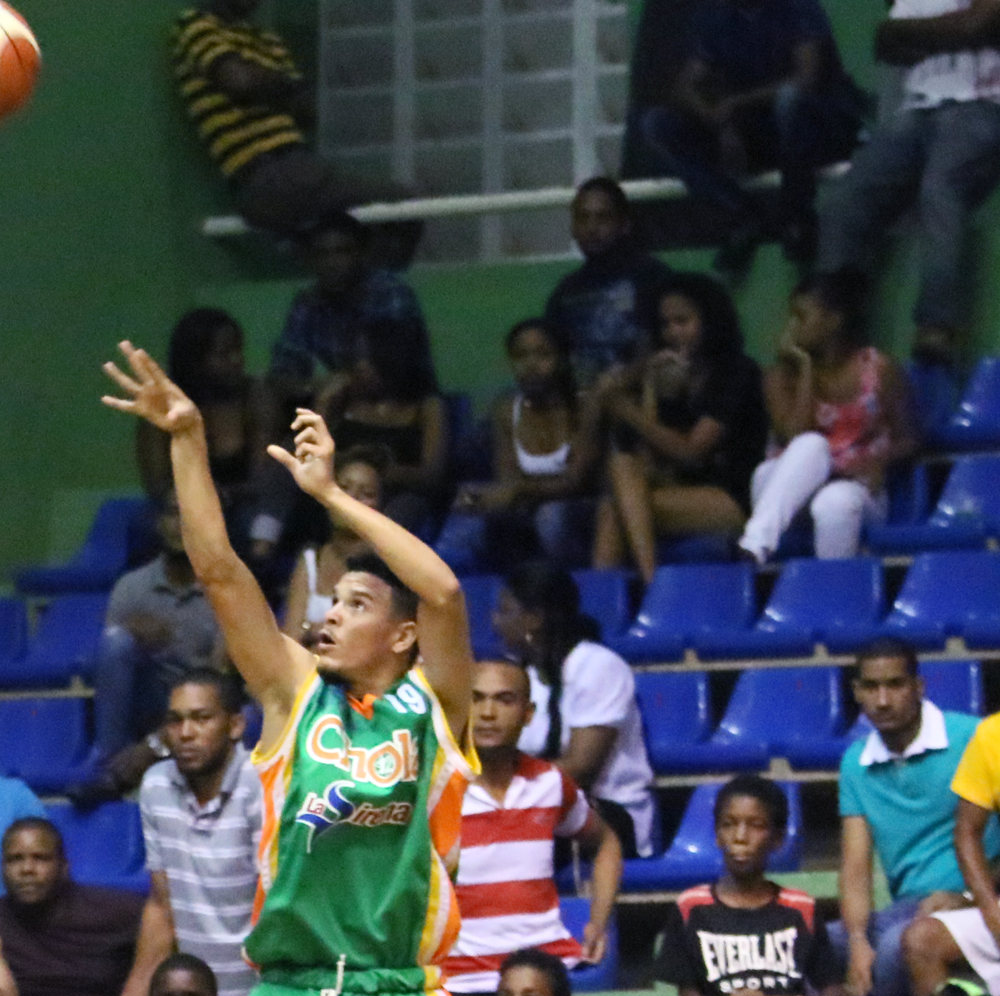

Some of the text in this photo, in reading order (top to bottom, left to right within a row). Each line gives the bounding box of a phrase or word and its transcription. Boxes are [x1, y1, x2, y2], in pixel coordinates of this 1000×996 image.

[384, 684, 427, 714] 19
[303, 793, 327, 817] La
[697, 927, 803, 983] EVERLAST
[719, 976, 789, 994] SPORT
